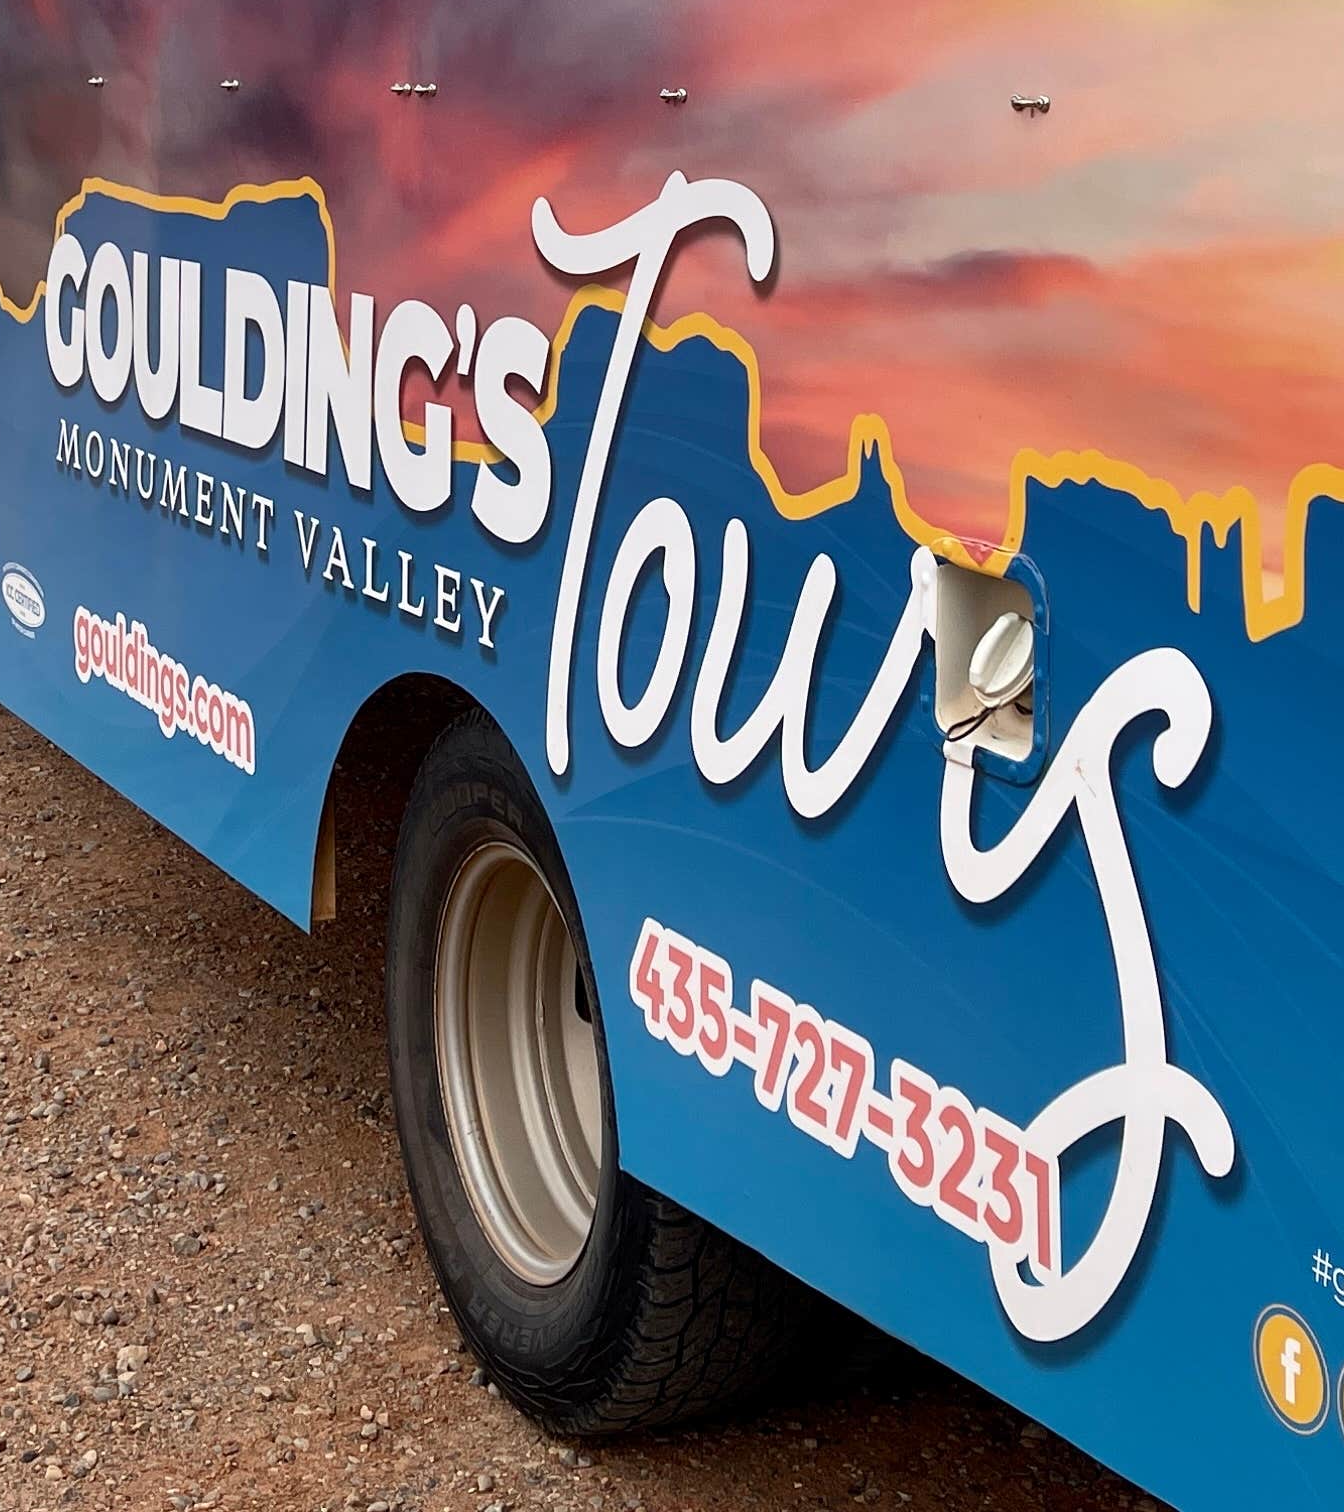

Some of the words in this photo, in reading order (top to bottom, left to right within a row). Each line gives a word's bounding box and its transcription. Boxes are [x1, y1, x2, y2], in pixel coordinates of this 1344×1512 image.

[45, 233, 552, 544] GOULDING'S
[56, 418, 275, 551] MONUMENT
[294, 509, 506, 649] VALLEY
[74, 608, 255, 770] gouldings.com
[636, 931, 1053, 1272] 435-727-3231
